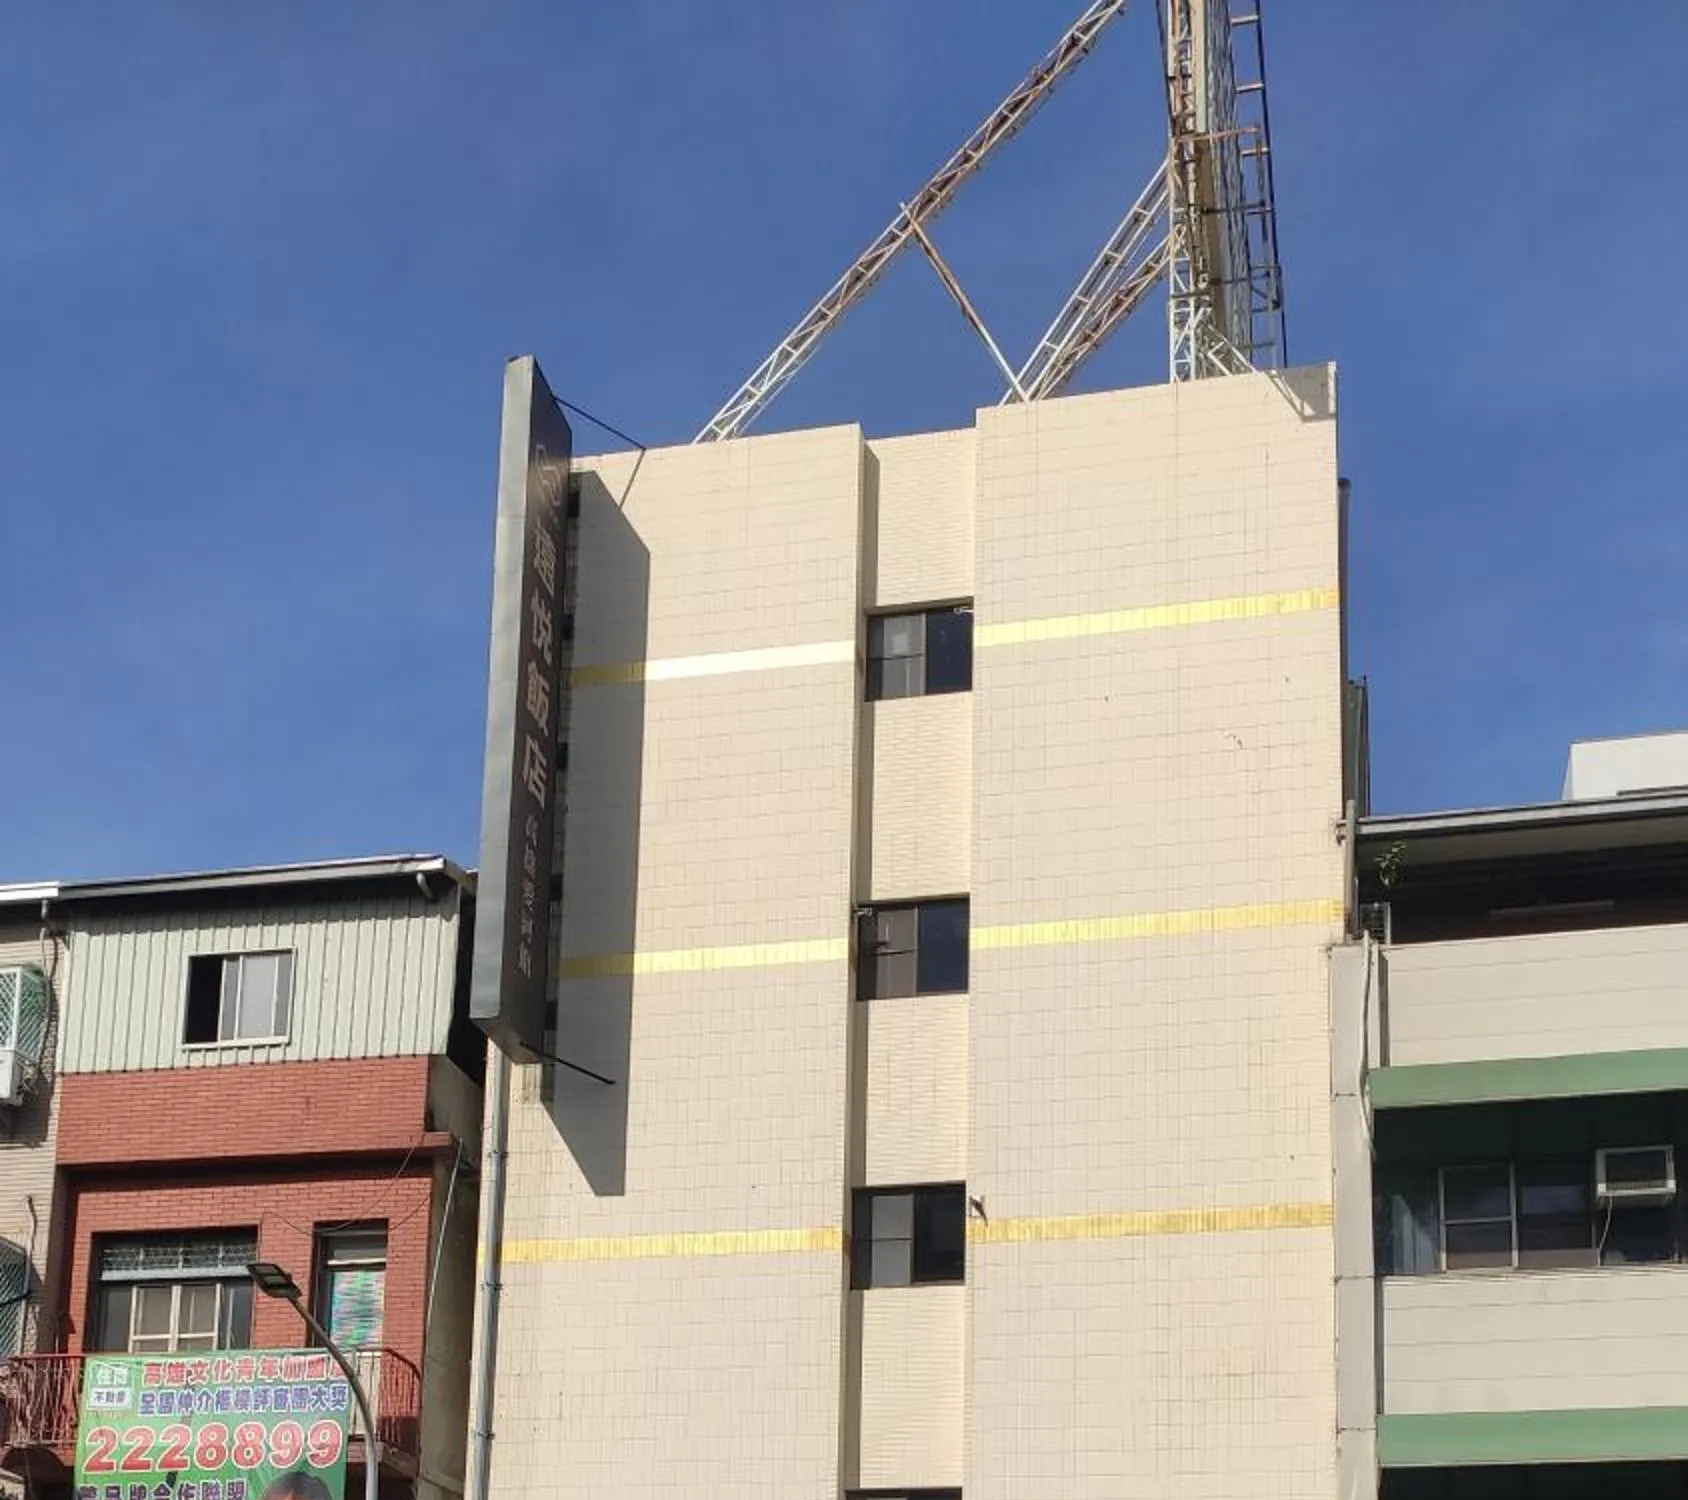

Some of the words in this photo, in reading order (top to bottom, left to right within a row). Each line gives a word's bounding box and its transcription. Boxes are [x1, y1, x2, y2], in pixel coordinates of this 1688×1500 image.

[523, 516, 557, 809] 遠悅飯店
[83, 1419, 343, 1473] 2228899
